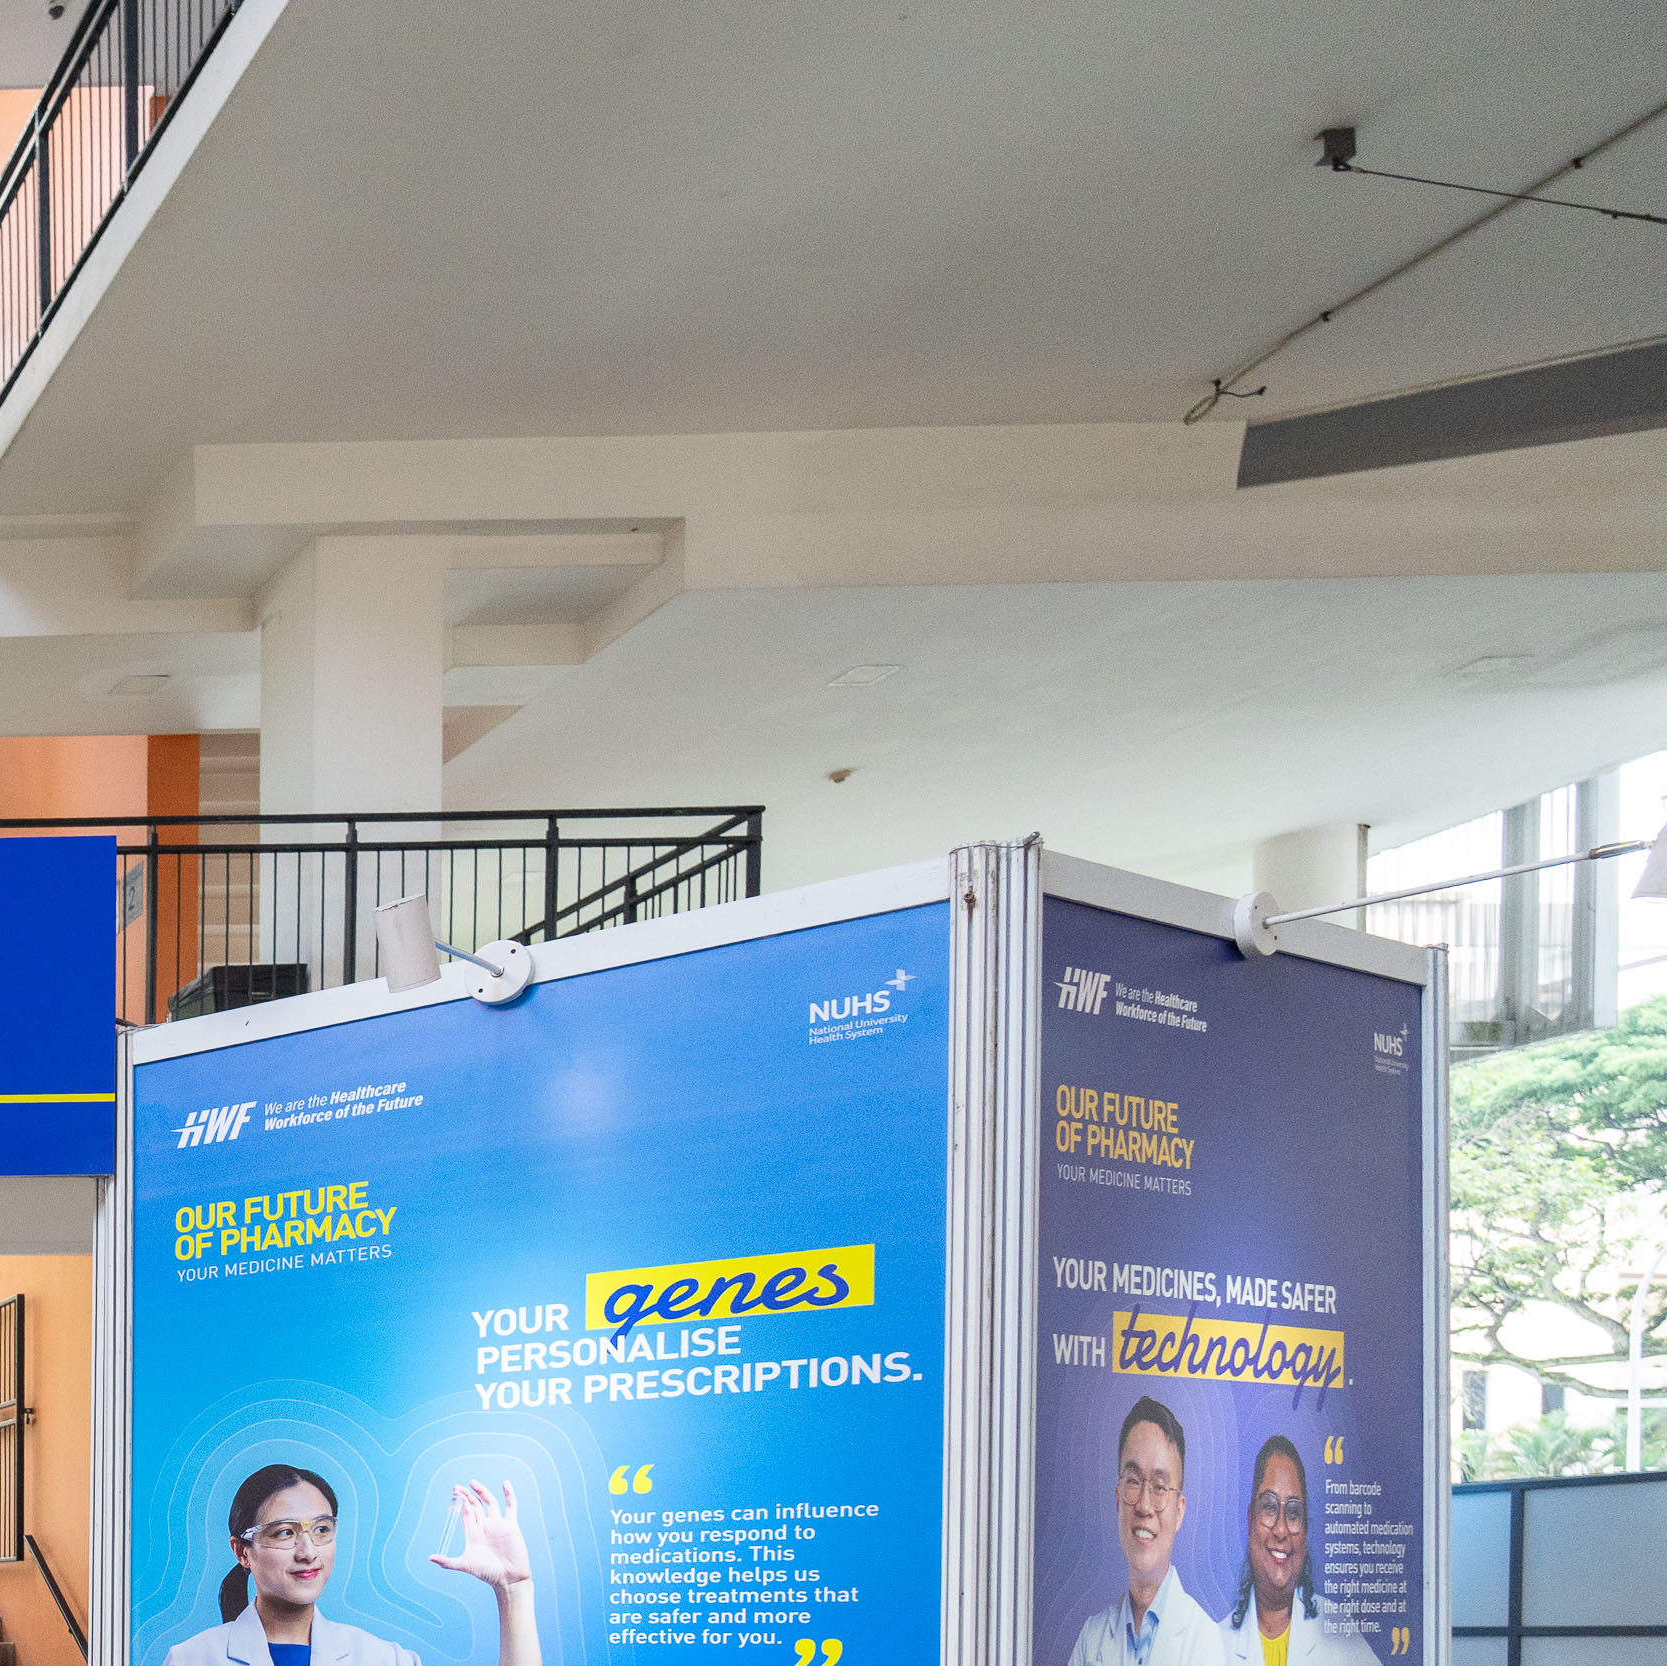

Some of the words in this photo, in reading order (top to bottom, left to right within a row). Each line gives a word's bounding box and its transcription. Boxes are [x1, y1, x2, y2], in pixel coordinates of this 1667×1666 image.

[809, 990, 890, 1024] NUHS
[1054, 966, 1111, 1016] HWF
[809, 1022, 853, 1035] National
[856, 1014, 908, 1028] University
[809, 1033, 843, 1045] Health
[845, 1027, 883, 1040] System
[1373, 1032, 1403, 1057] NUHS
[170, 1101, 257, 1149] HWF
[472, 1303, 569, 1339] YOUR
[604, 1264, 850, 1355] genes
[1053, 1256, 1107, 1292] YOUR
[1113, 1262, 1223, 1308] MEDICINES,
[1226, 1275, 1278, 1309] MADE
[1281, 1281, 1337, 1315] SAFER
[476, 1324, 742, 1374] PERSONALISE
[1053, 1334, 1105, 1368] WITH
[475, 1378, 572, 1410] YOUR
[584, 1352, 923, 1404] PRESCRIPTIONS.
